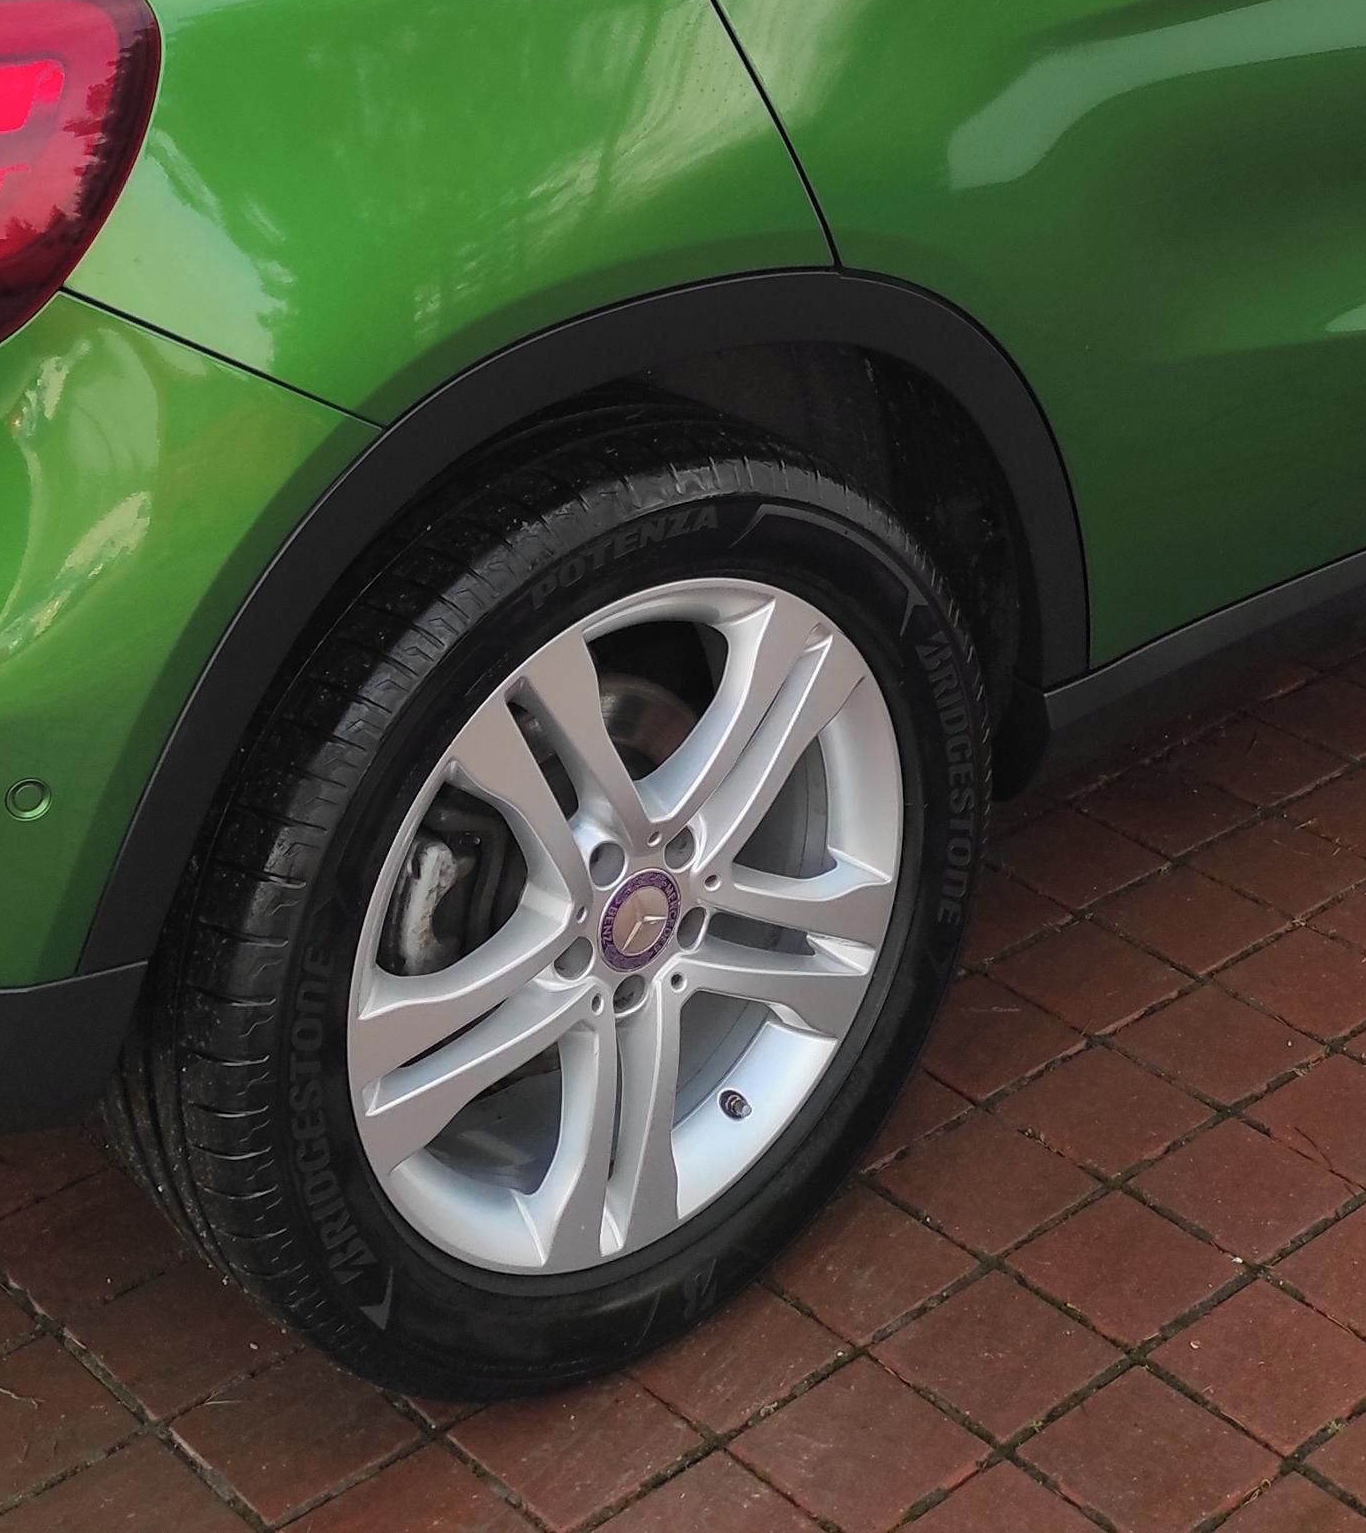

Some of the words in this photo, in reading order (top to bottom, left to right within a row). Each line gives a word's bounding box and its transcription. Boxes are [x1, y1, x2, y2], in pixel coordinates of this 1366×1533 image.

[528, 504, 721, 612] POTENZA
[913, 629, 977, 927] BRIDGESTONE
[288, 945, 381, 1286] BRIDGESTONE
